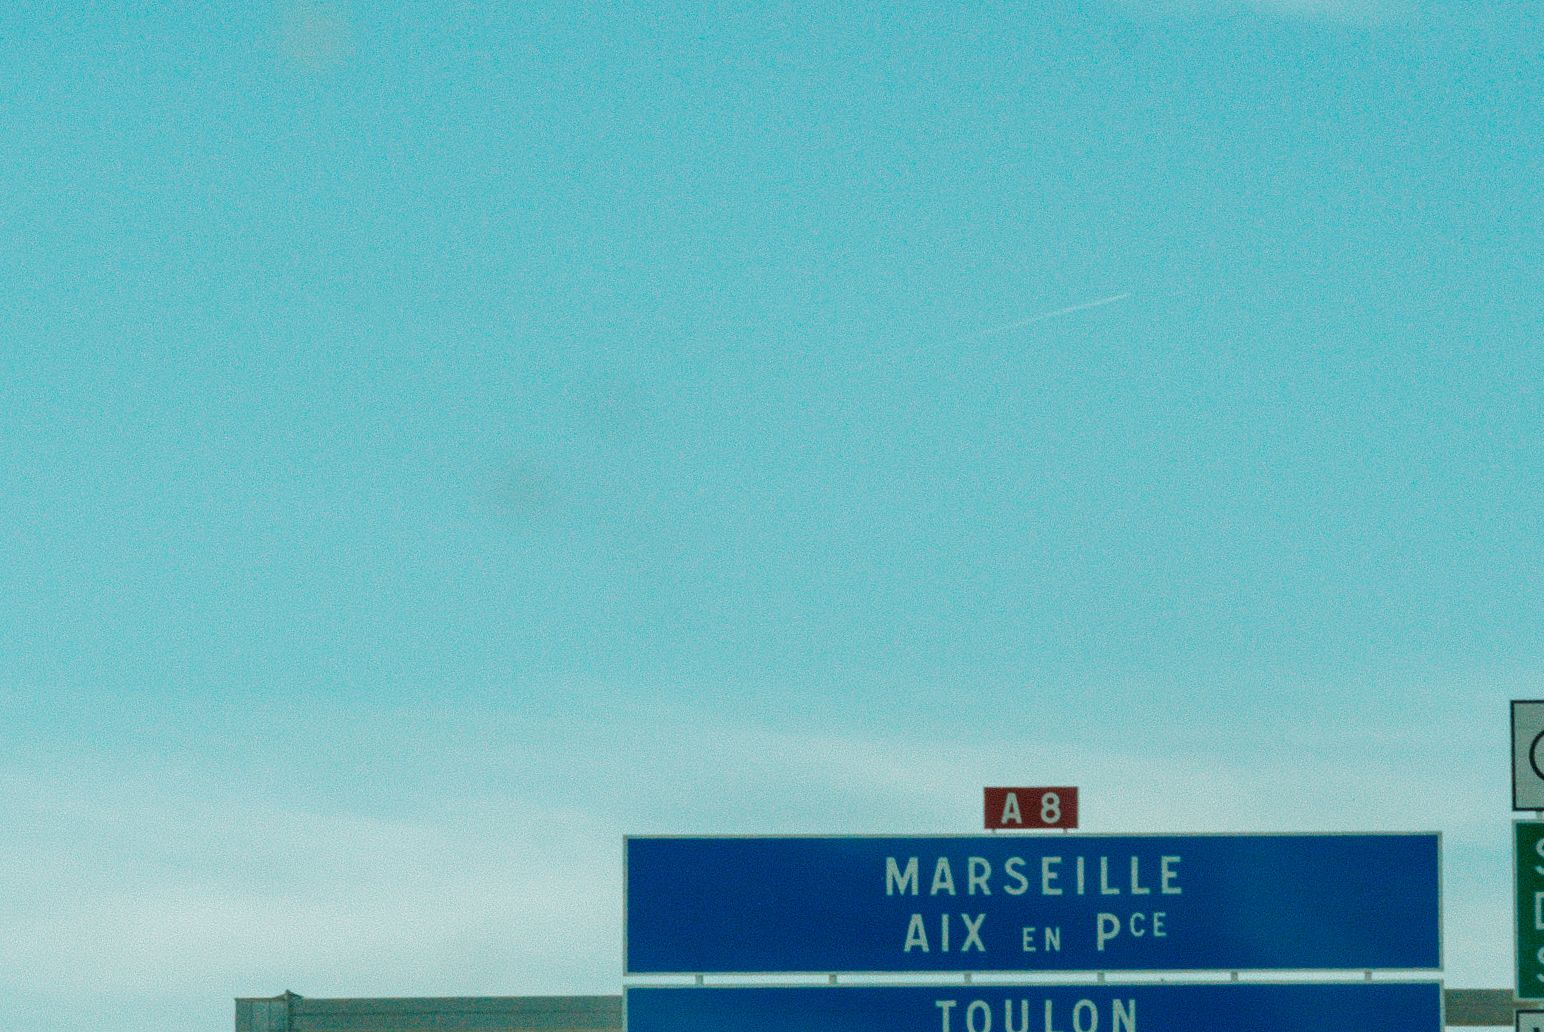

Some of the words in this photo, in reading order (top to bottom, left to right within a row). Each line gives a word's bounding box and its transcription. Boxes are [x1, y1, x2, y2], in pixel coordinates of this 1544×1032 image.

[885, 855, 1182, 896] MARSEILLE
[904, 913, 986, 953] AIX
[1022, 926, 1061, 952] EN
